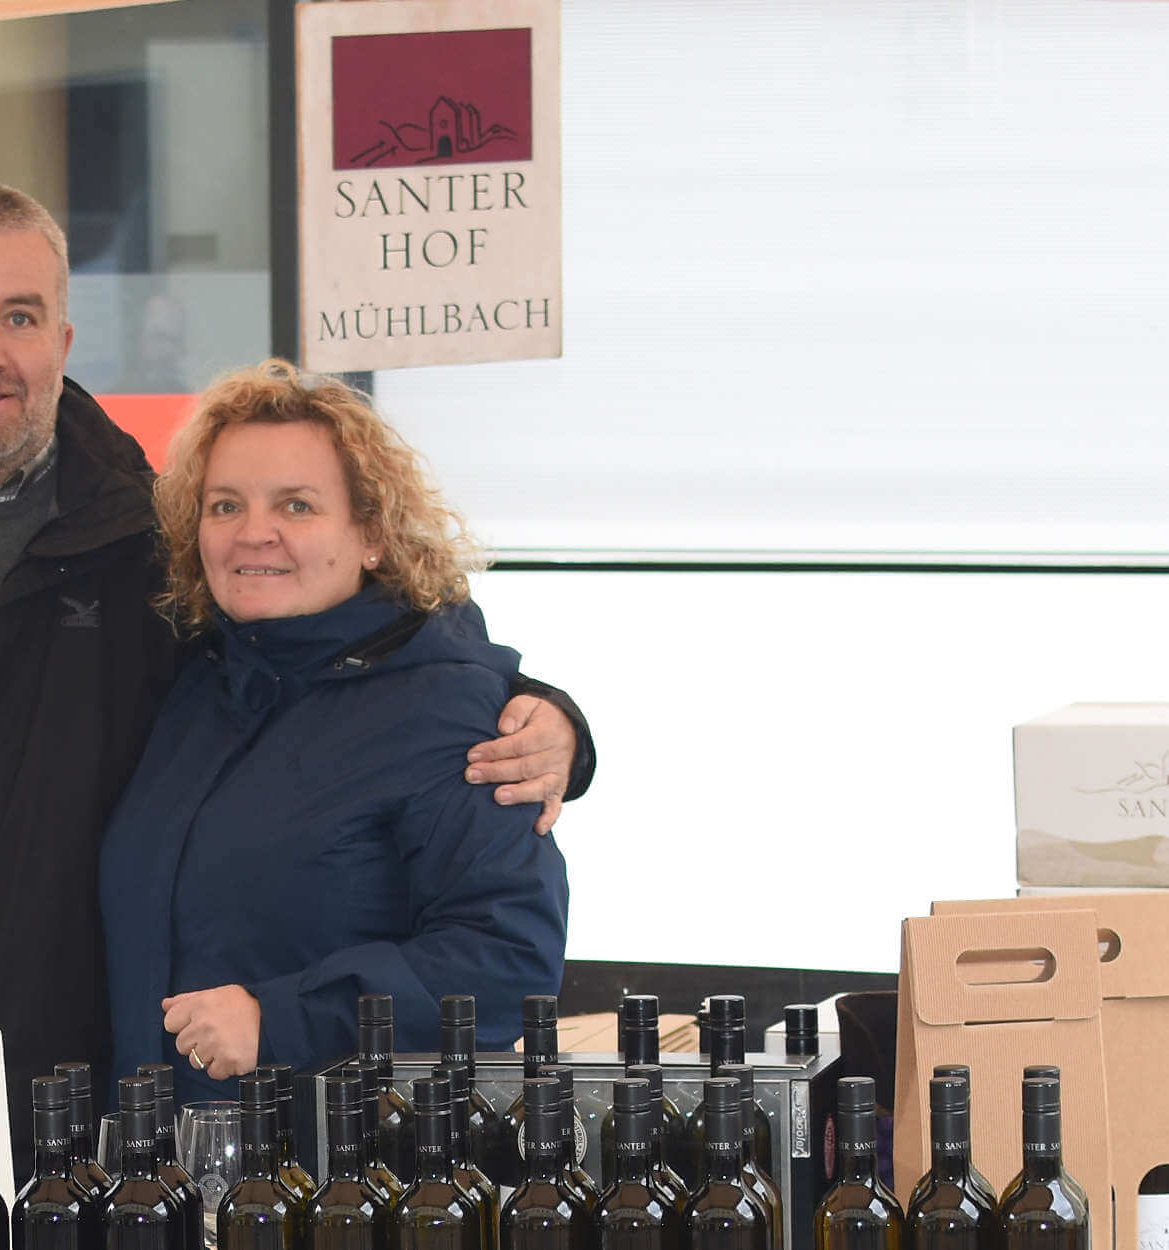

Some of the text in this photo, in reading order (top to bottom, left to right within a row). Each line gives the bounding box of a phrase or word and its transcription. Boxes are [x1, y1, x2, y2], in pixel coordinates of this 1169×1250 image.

[334, 172, 529, 218] SANTER
[380, 229, 488, 270] HOF
[318, 298, 550, 341] MÜHLBACH
[1118, 799, 1168, 818] SAN
